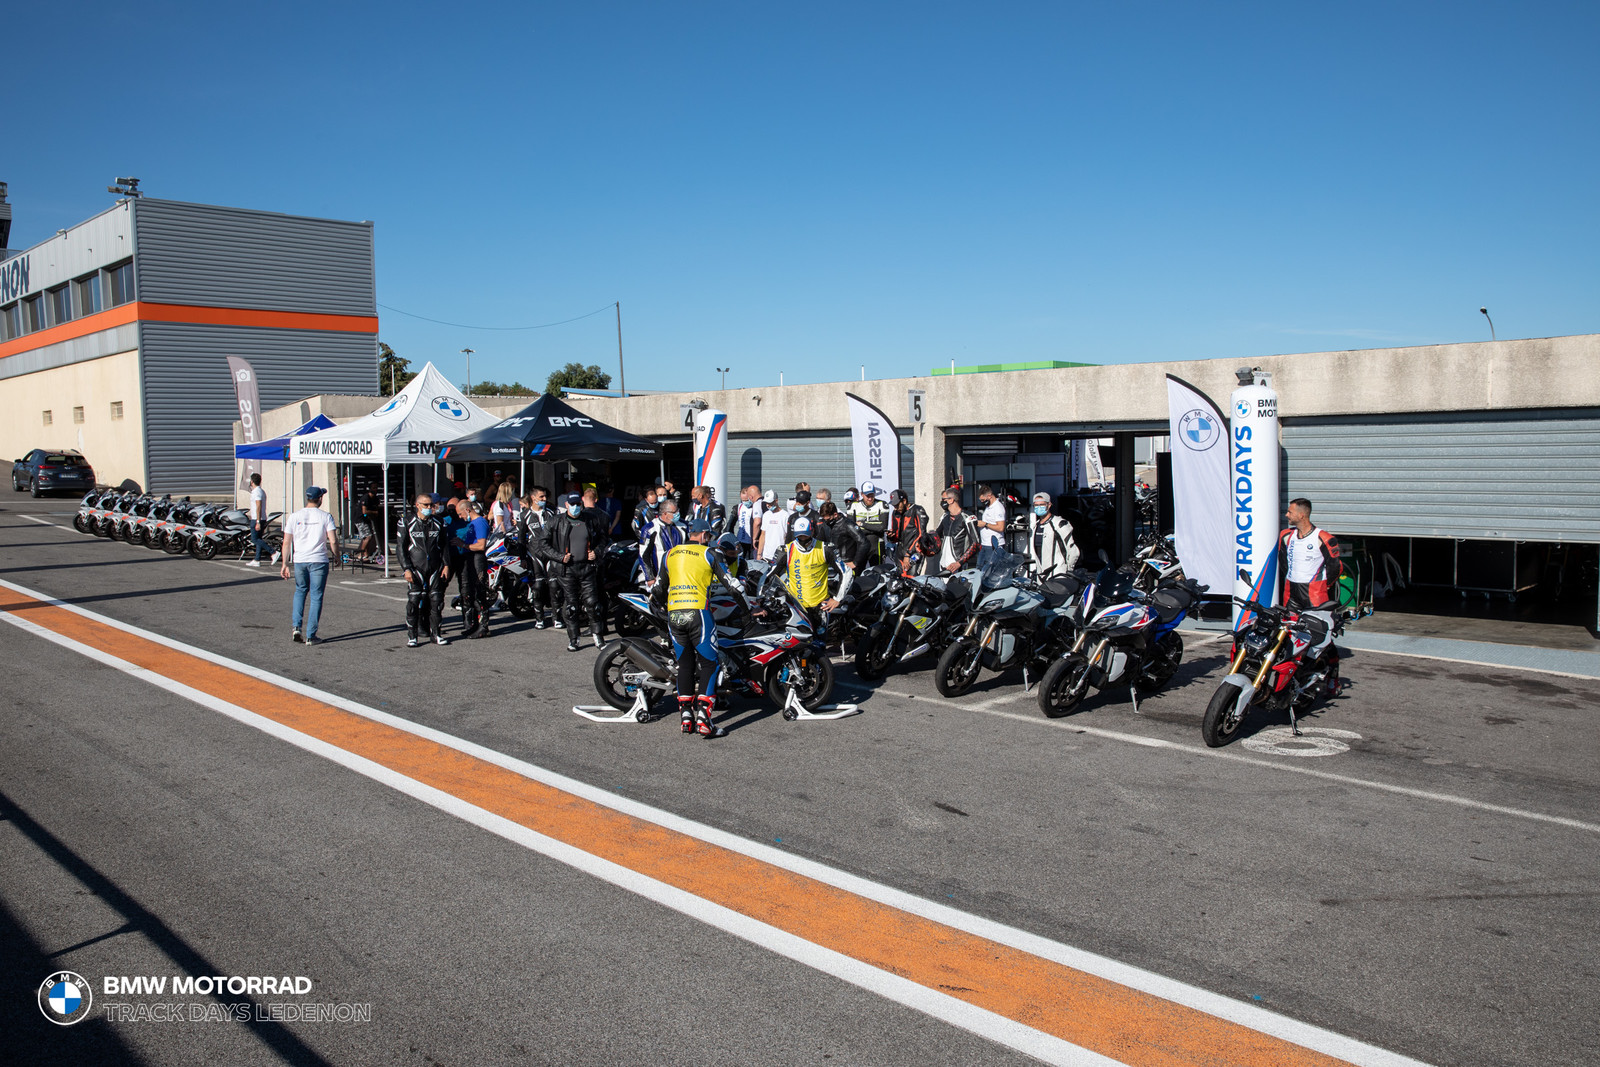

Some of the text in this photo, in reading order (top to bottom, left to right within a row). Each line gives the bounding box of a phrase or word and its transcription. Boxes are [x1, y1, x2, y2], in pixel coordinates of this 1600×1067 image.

[0, 254, 30, 304] NON
[913, 395, 922, 422] 5
[548, 416, 594, 428] BMC
[684, 409, 694, 431] 4
[299, 440, 373, 455] BMW MOTORRAD
[408, 440, 447, 455] BM
[619, 446, 656, 454] bmc-moto.com
[1235, 425, 1253, 581] TRACKDAYS
